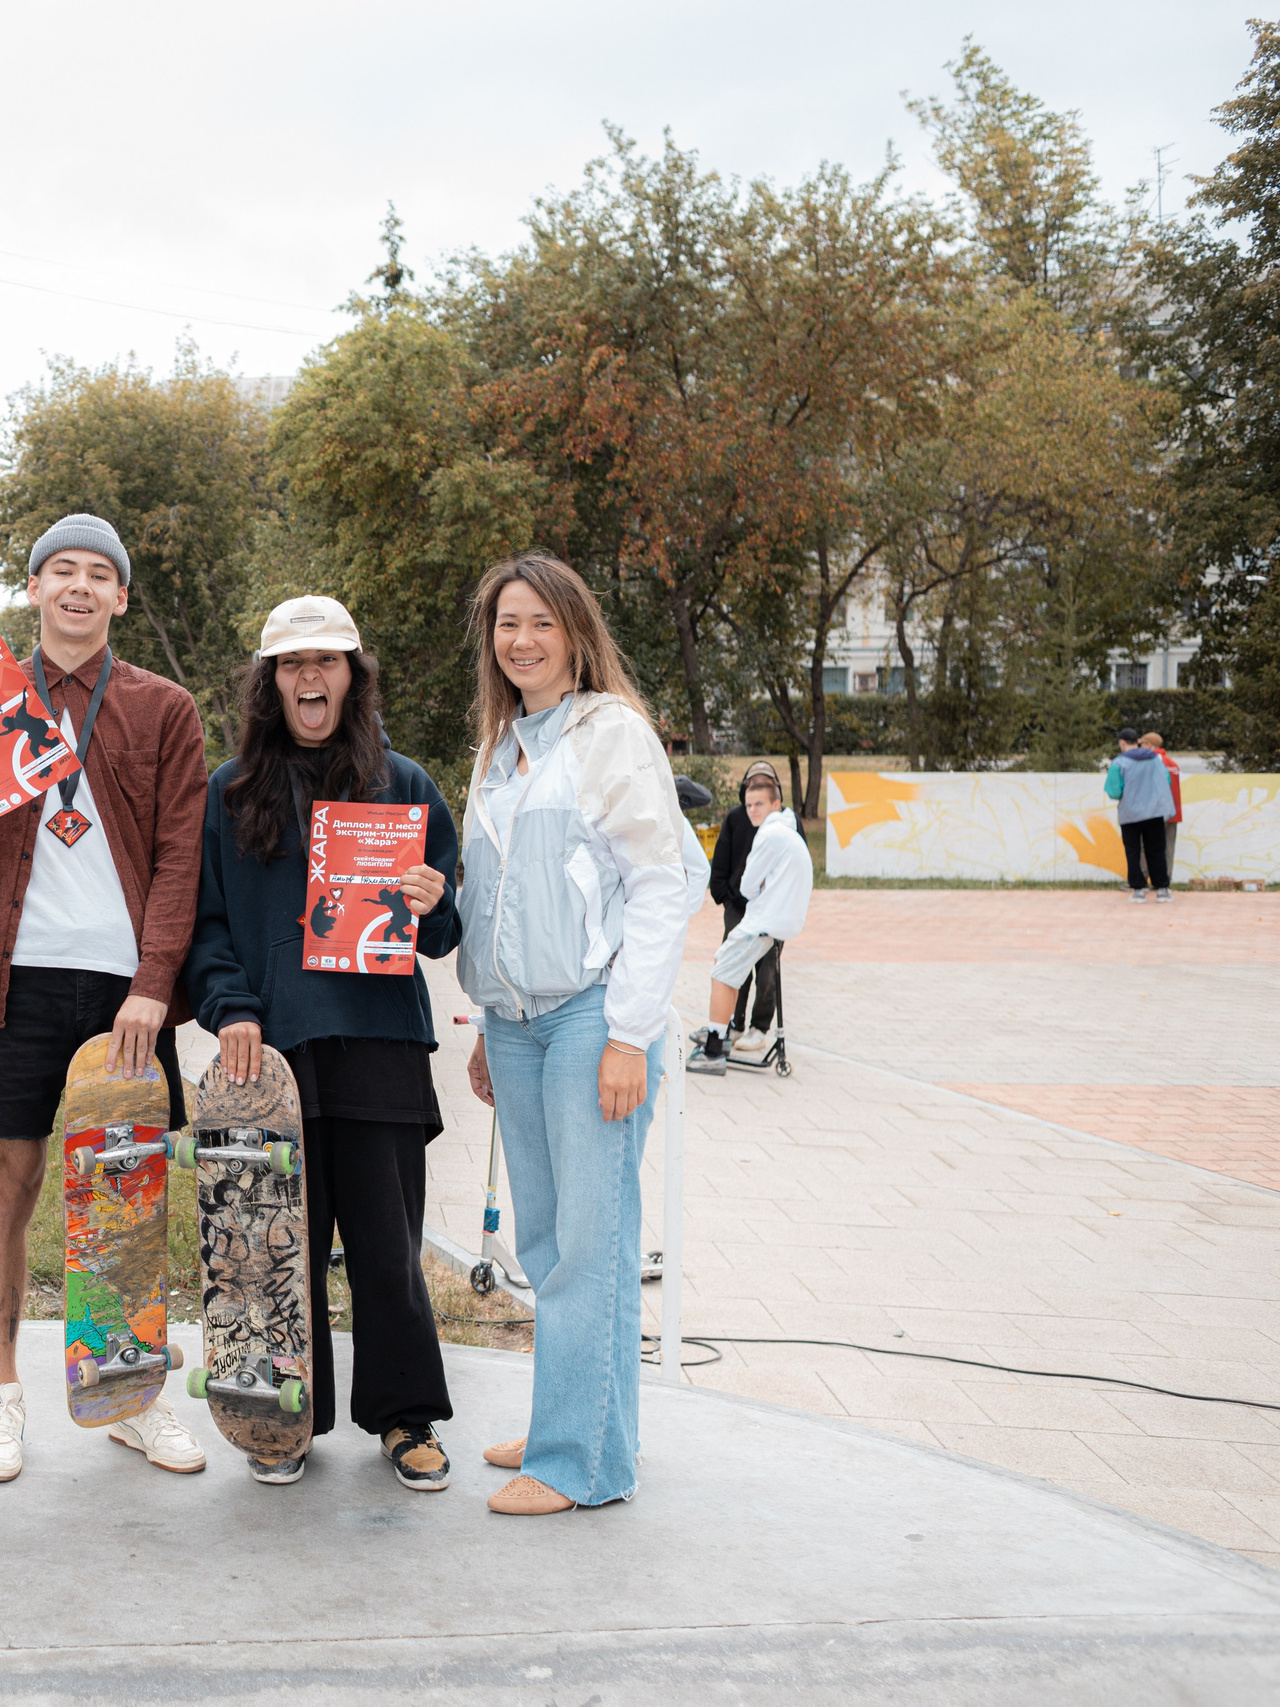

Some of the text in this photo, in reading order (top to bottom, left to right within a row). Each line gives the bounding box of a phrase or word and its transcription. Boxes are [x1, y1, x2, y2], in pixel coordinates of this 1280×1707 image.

[64, 816, 73, 828] 1
[332, 820, 373, 829] Диплом
[388, 822, 394, 830] I
[50, 821, 72, 844] ЖАРА
[335, 829, 419, 840] экстрим-турнира
[310, 806, 330, 884] ЖАРА
[357, 837, 398, 847] «Жара»
[353, 855, 396, 863] скейтбординг
